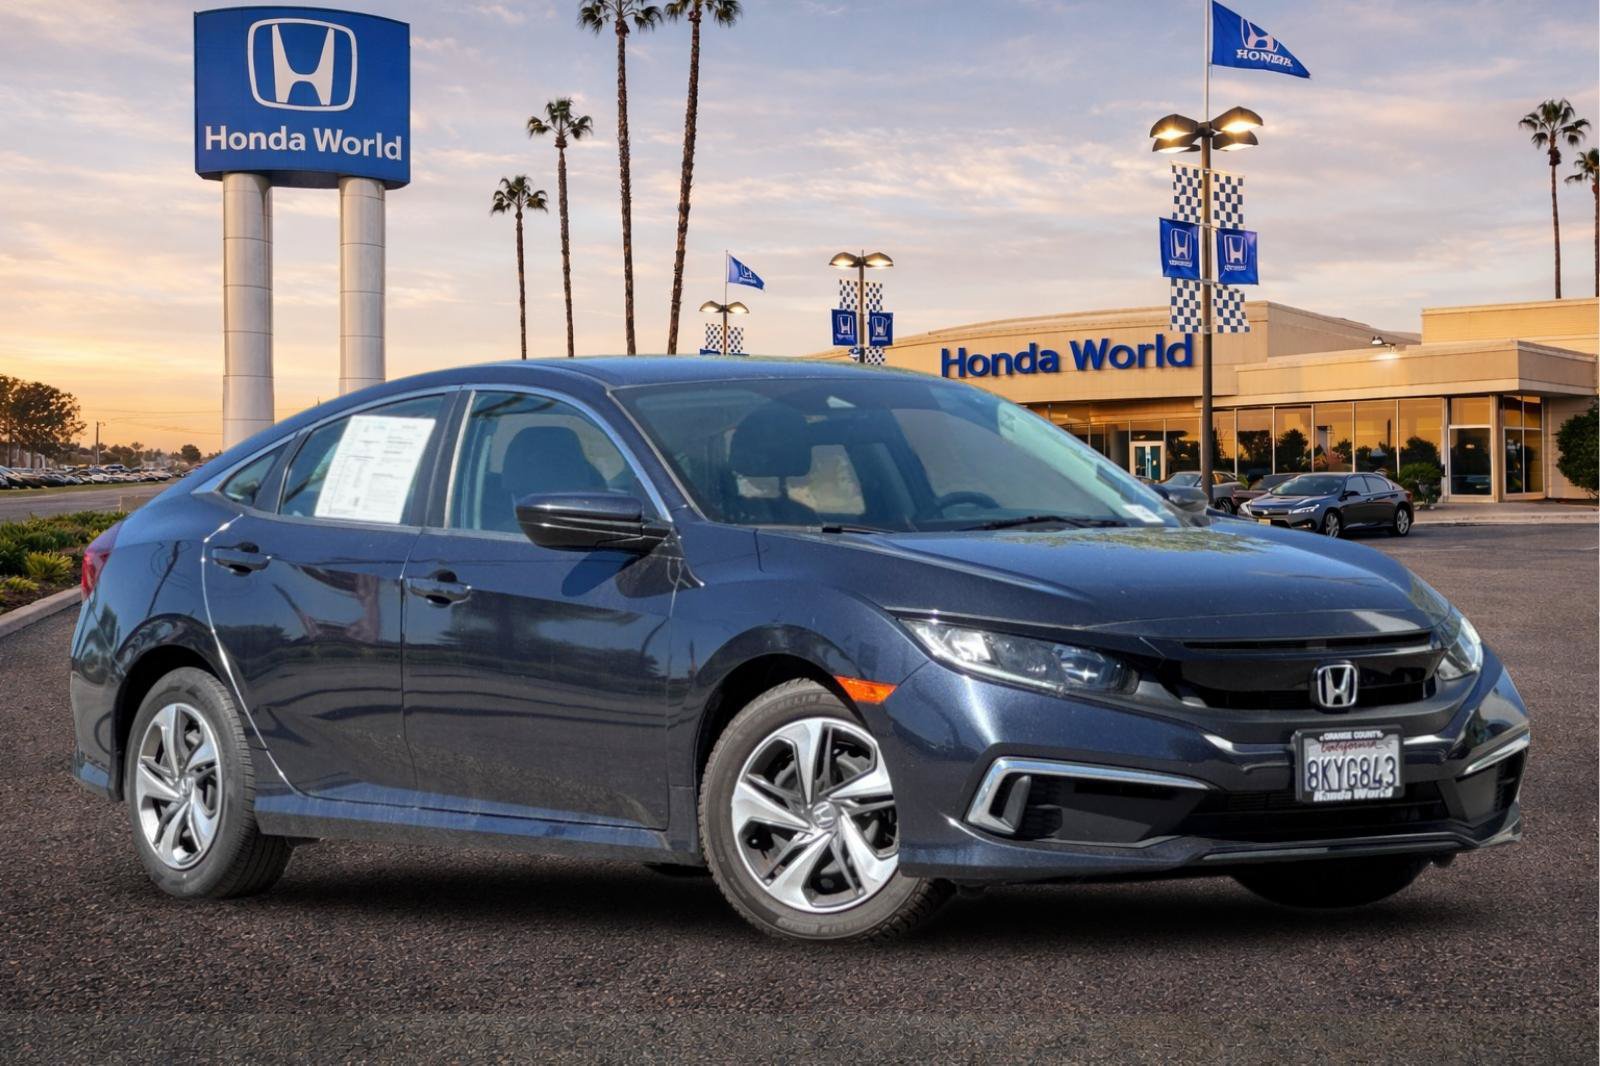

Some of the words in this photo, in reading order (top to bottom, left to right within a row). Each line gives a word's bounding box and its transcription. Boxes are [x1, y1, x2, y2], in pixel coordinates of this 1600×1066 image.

[205, 125, 306, 151] Honda
[313, 127, 402, 160] World
[941, 342, 1060, 378] Honda
[1069, 333, 1194, 371] World
[1307, 756, 1396, 791] 8KYG843
